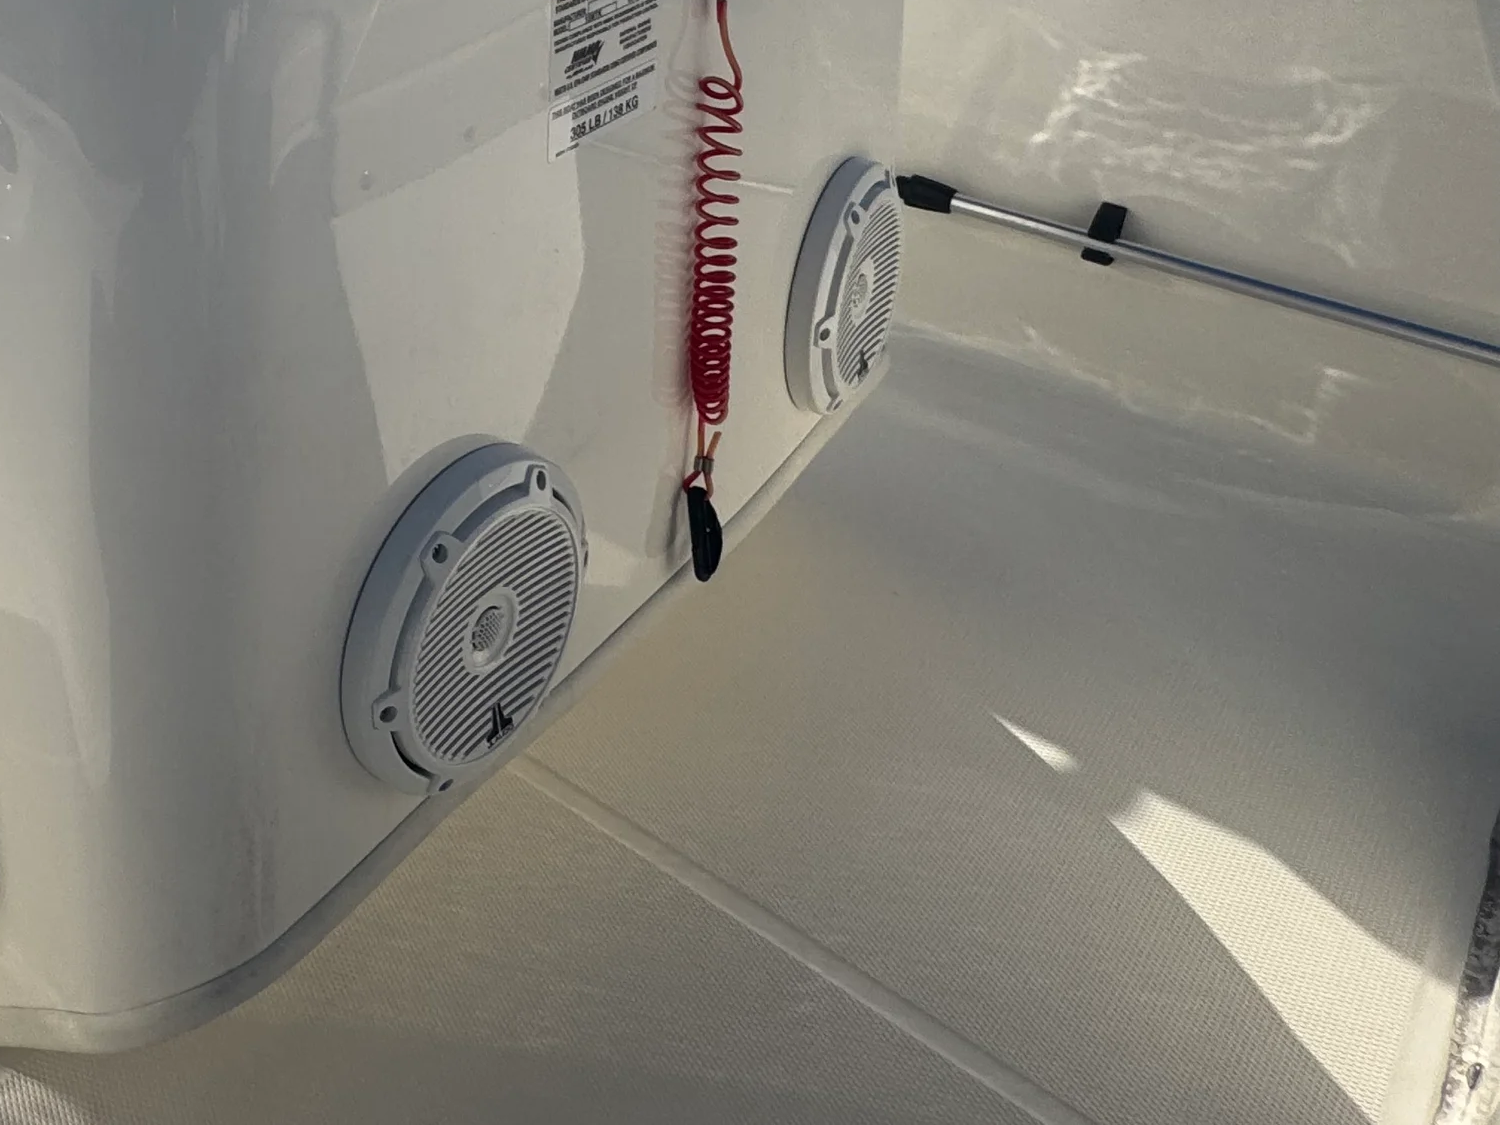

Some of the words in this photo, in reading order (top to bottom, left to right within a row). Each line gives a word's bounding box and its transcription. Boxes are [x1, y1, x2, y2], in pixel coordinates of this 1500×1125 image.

[570, 122, 587, 139] 305
[589, 114, 601, 130] LB
[625, 94, 639, 113] KG
